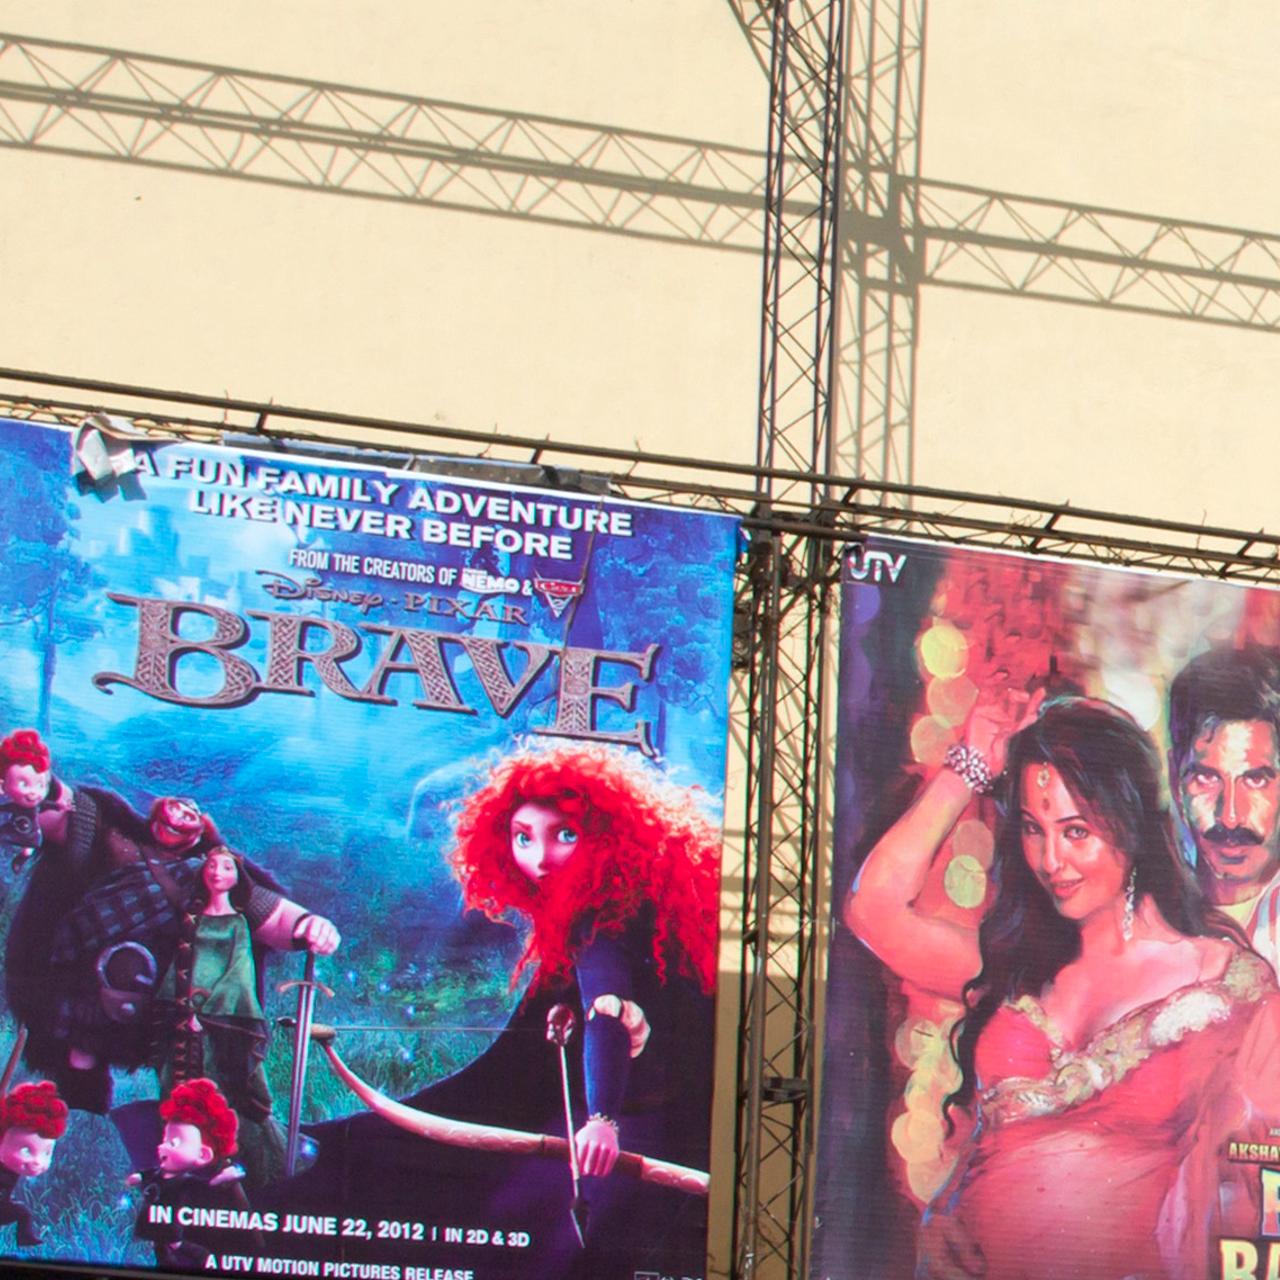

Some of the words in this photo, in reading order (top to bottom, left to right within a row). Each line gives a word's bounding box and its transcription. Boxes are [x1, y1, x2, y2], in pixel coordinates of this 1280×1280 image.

[168, 455, 248, 488] FUN
[256, 466, 399, 505] FAMILY
[407, 487, 634, 537] ADVENTURE
[189, 489, 279, 524] LIKE
[285, 501, 413, 540] NEVER
[422, 519, 574, 560] BEFORE
[288, 548, 329, 570] FROM
[333, 553, 360, 573] THE
[363, 557, 435, 584] CREATORS
[438, 566, 458, 586] OF
[404, 592, 529, 626] PIXAR
[92, 592, 662, 760] BRAVE
[149, 1204, 172, 1224] IN
[177, 1206, 279, 1233] CINEMAS
[283, 1214, 336, 1237] JUNE
[342, 1218, 372, 1241] 22,
[378, 1221, 424, 1242] 2012
[445, 1226, 463, 1244] IN
[467, 1228, 489, 1246] 2D
[492, 1230, 505, 1247] &
[508, 1231, 531, 1248] 3D
[206, 1253, 218, 1270] A
[222, 1254, 254, 1272] UTV
[257, 1257, 319, 1277] MOTION
